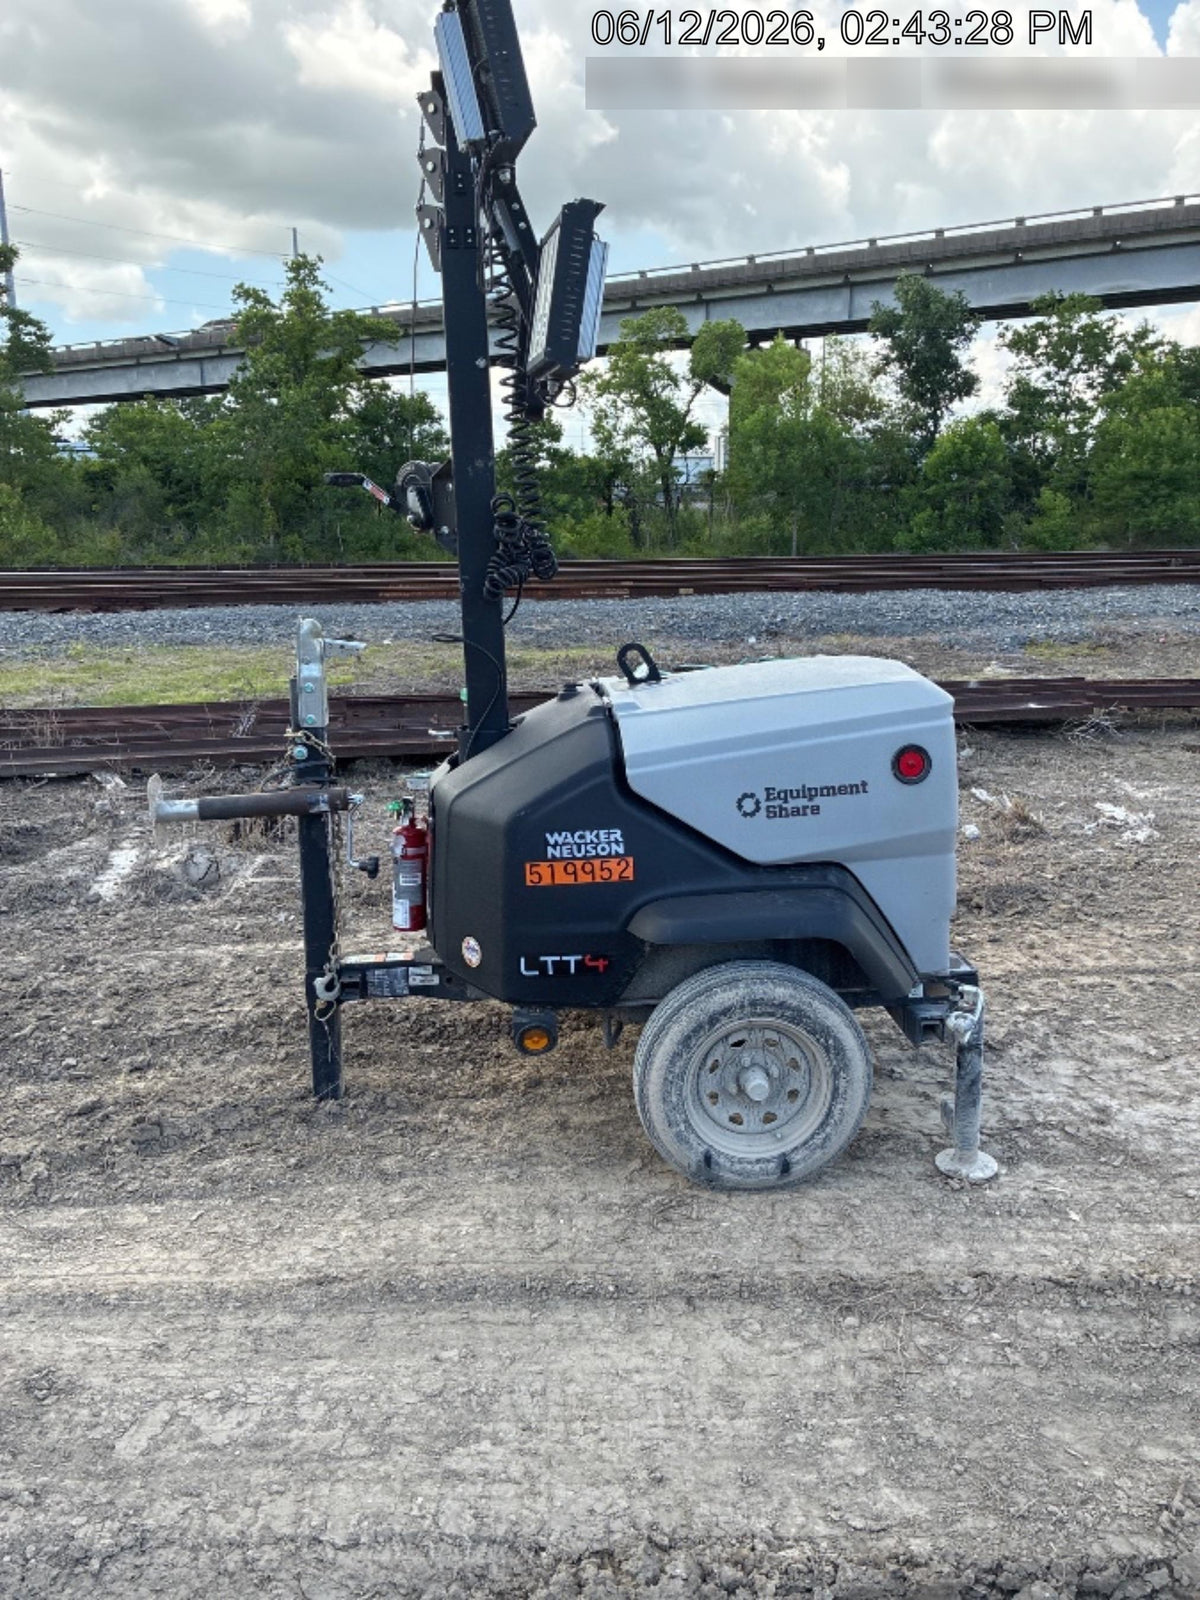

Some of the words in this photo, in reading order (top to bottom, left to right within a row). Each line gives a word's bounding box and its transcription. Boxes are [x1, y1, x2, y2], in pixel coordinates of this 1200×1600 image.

[764, 780, 869, 804] Equipment
[765, 804, 821, 820] Share
[545, 829, 624, 846] WACKER
[547, 842, 625, 859] NEUSON
[528, 858, 631, 885] 519952
[520, 954, 609, 976] LTT4
